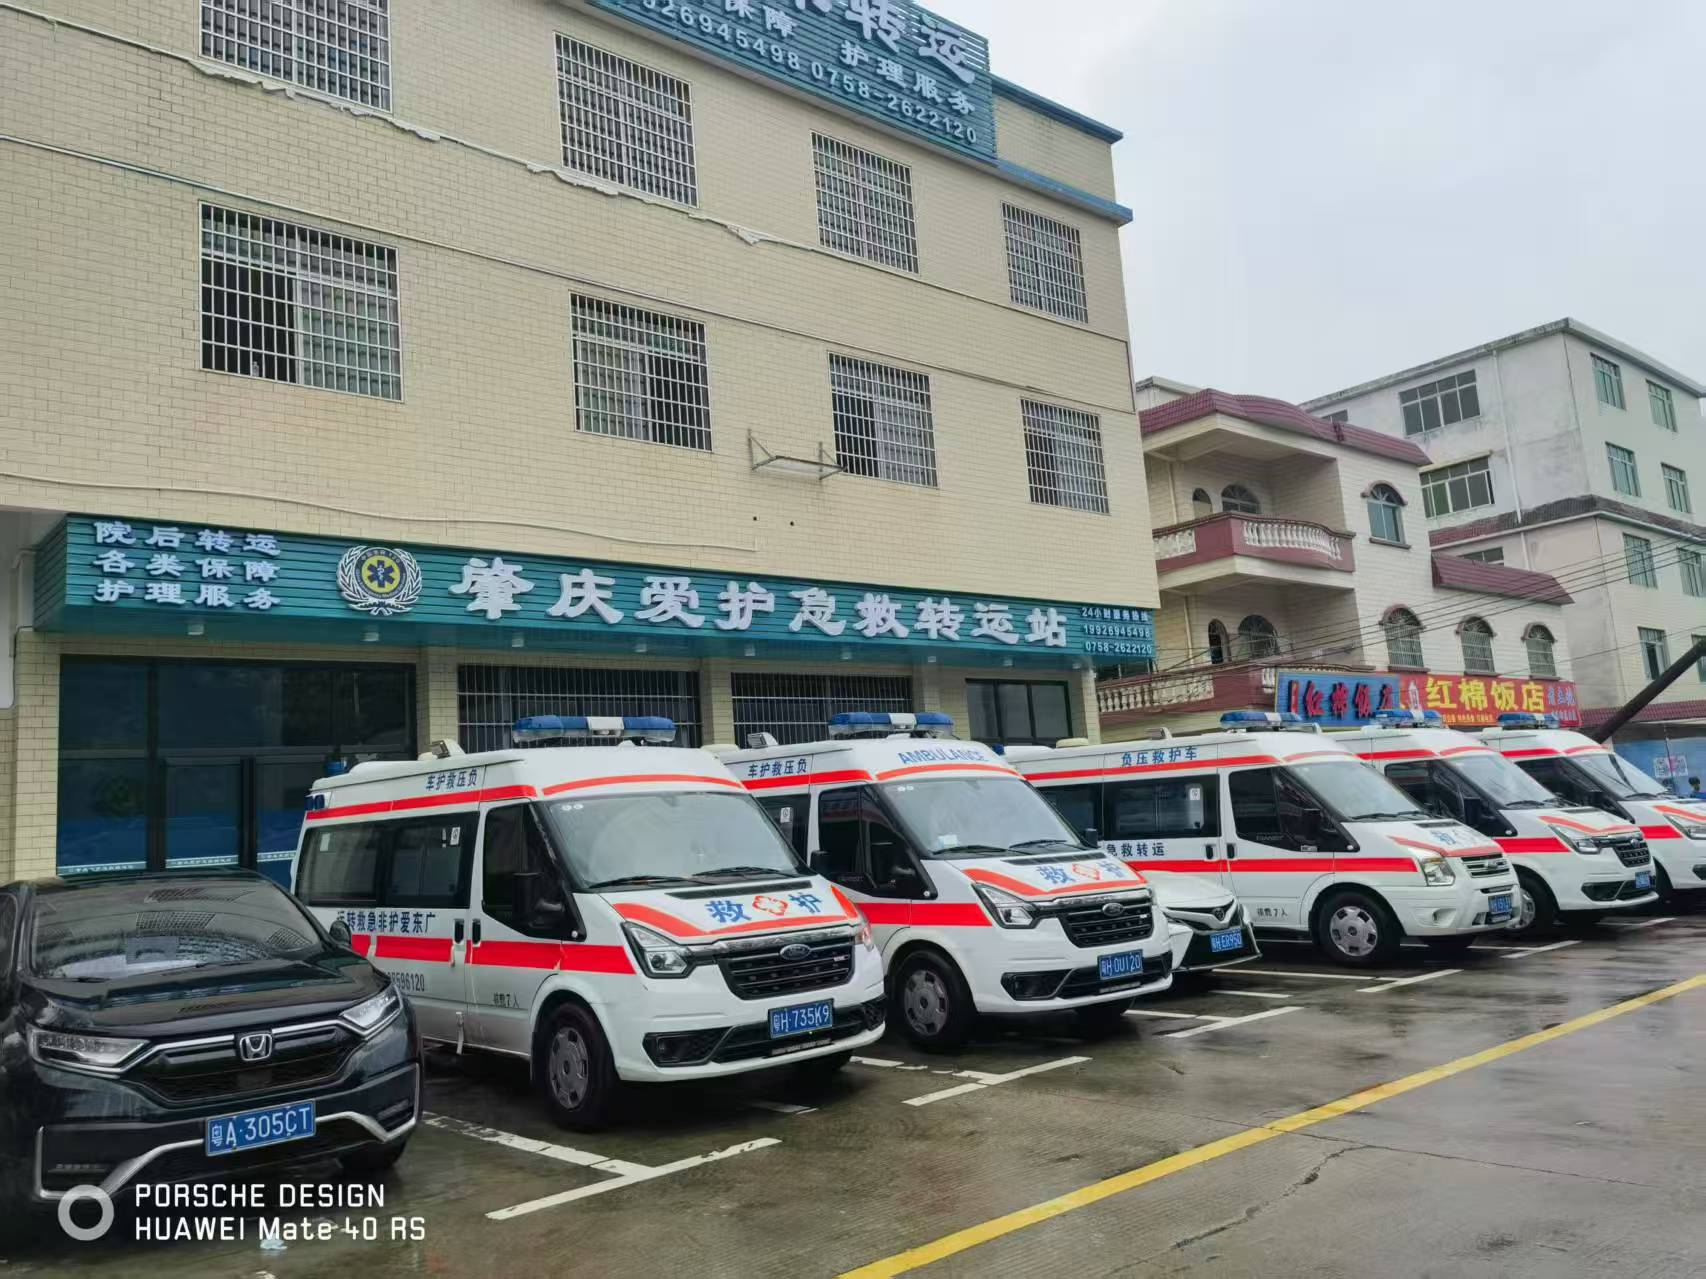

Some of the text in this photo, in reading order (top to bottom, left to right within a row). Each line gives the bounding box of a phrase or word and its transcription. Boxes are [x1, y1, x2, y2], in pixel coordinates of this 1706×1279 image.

[840, 40, 976, 115] 护理服务
[811, 63, 977, 142] 0758-2622120
[94, 521, 281, 556] 院后转运
[94, 550, 281, 583] 各类保障
[94, 580, 281, 611] 护理服务
[449, 557, 1068, 648] 肇庆爱护急救转运站
[1086, 641, 1152, 654] 0758-2622120
[1425, 677, 1545, 713] 红棉饭店
[1121, 746, 1199, 766] 负压救护车
